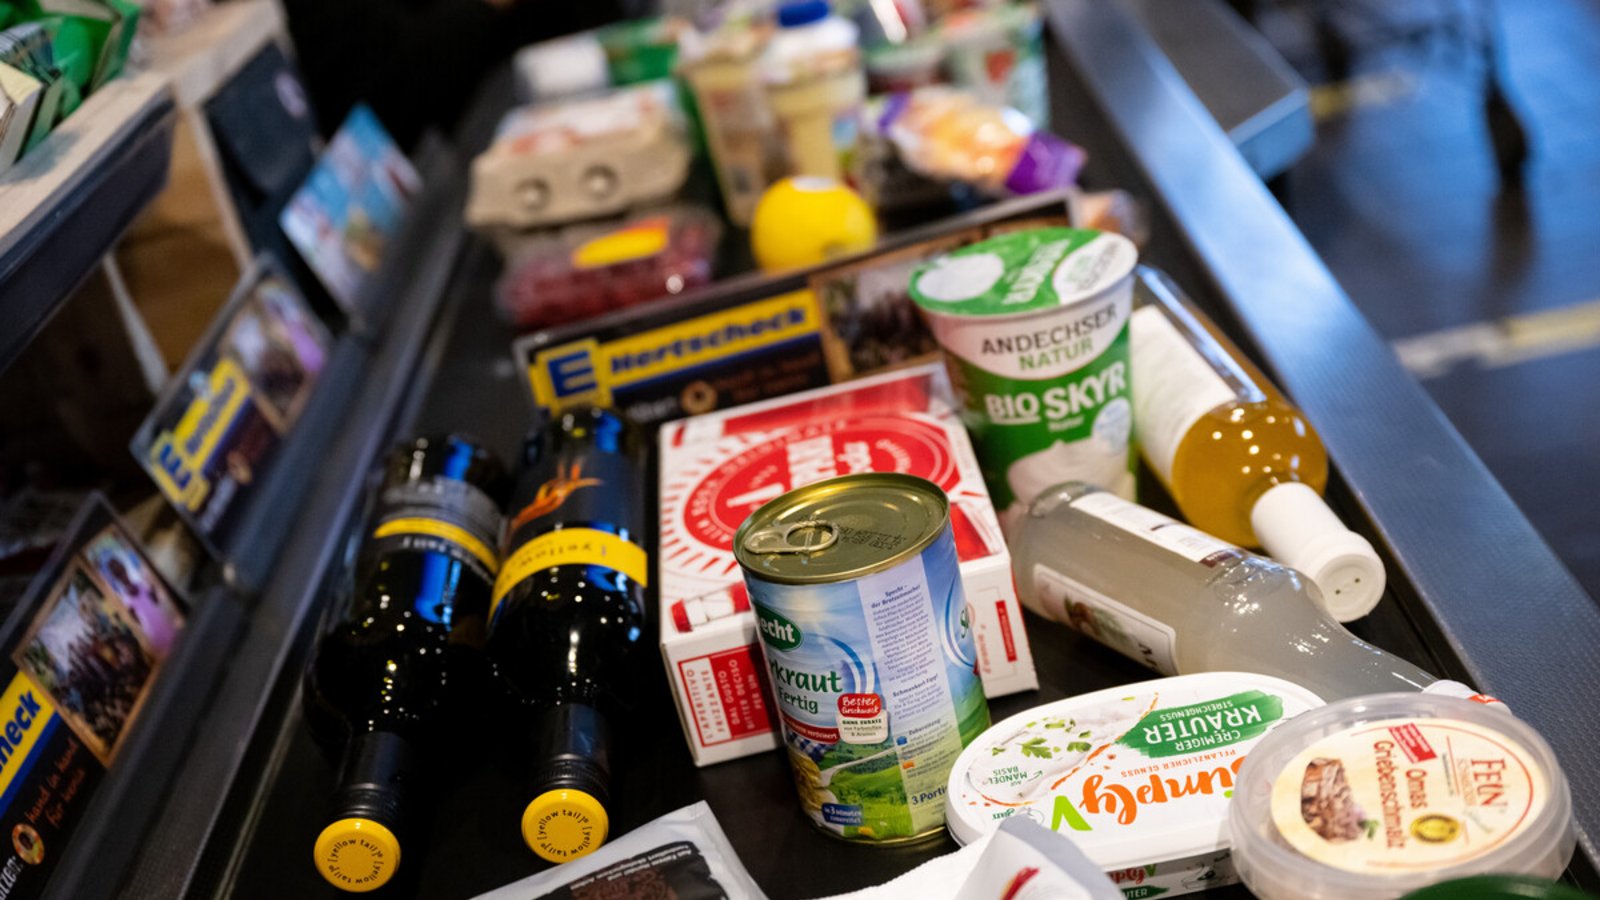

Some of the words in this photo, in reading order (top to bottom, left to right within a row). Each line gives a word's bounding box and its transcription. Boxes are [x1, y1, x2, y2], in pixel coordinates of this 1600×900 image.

[981, 303, 1117, 355] ANDECHSER
[1019, 337, 1094, 370] NATUR
[547, 350, 597, 398] E
[985, 391, 1041, 422] BIO
[1043, 360, 1126, 420] SKYR
[842, 696, 878, 707] Bester
[1160, 700, 1234, 721] STREICHGENUSS
[1143, 704, 1262, 744] KRÄUTER
[1175, 729, 1241, 751] CREMIGER
[993, 766, 1019, 776] BASIS
[1121, 764, 1160, 778] GENUSS
[1163, 749, 1237, 771] PFLANZLICHER
[912, 795, 919, 806] 3
[919, 785, 947, 803] Porti
[1405, 769, 1428, 809] Omas
[1110, 867, 1146, 885] ply
